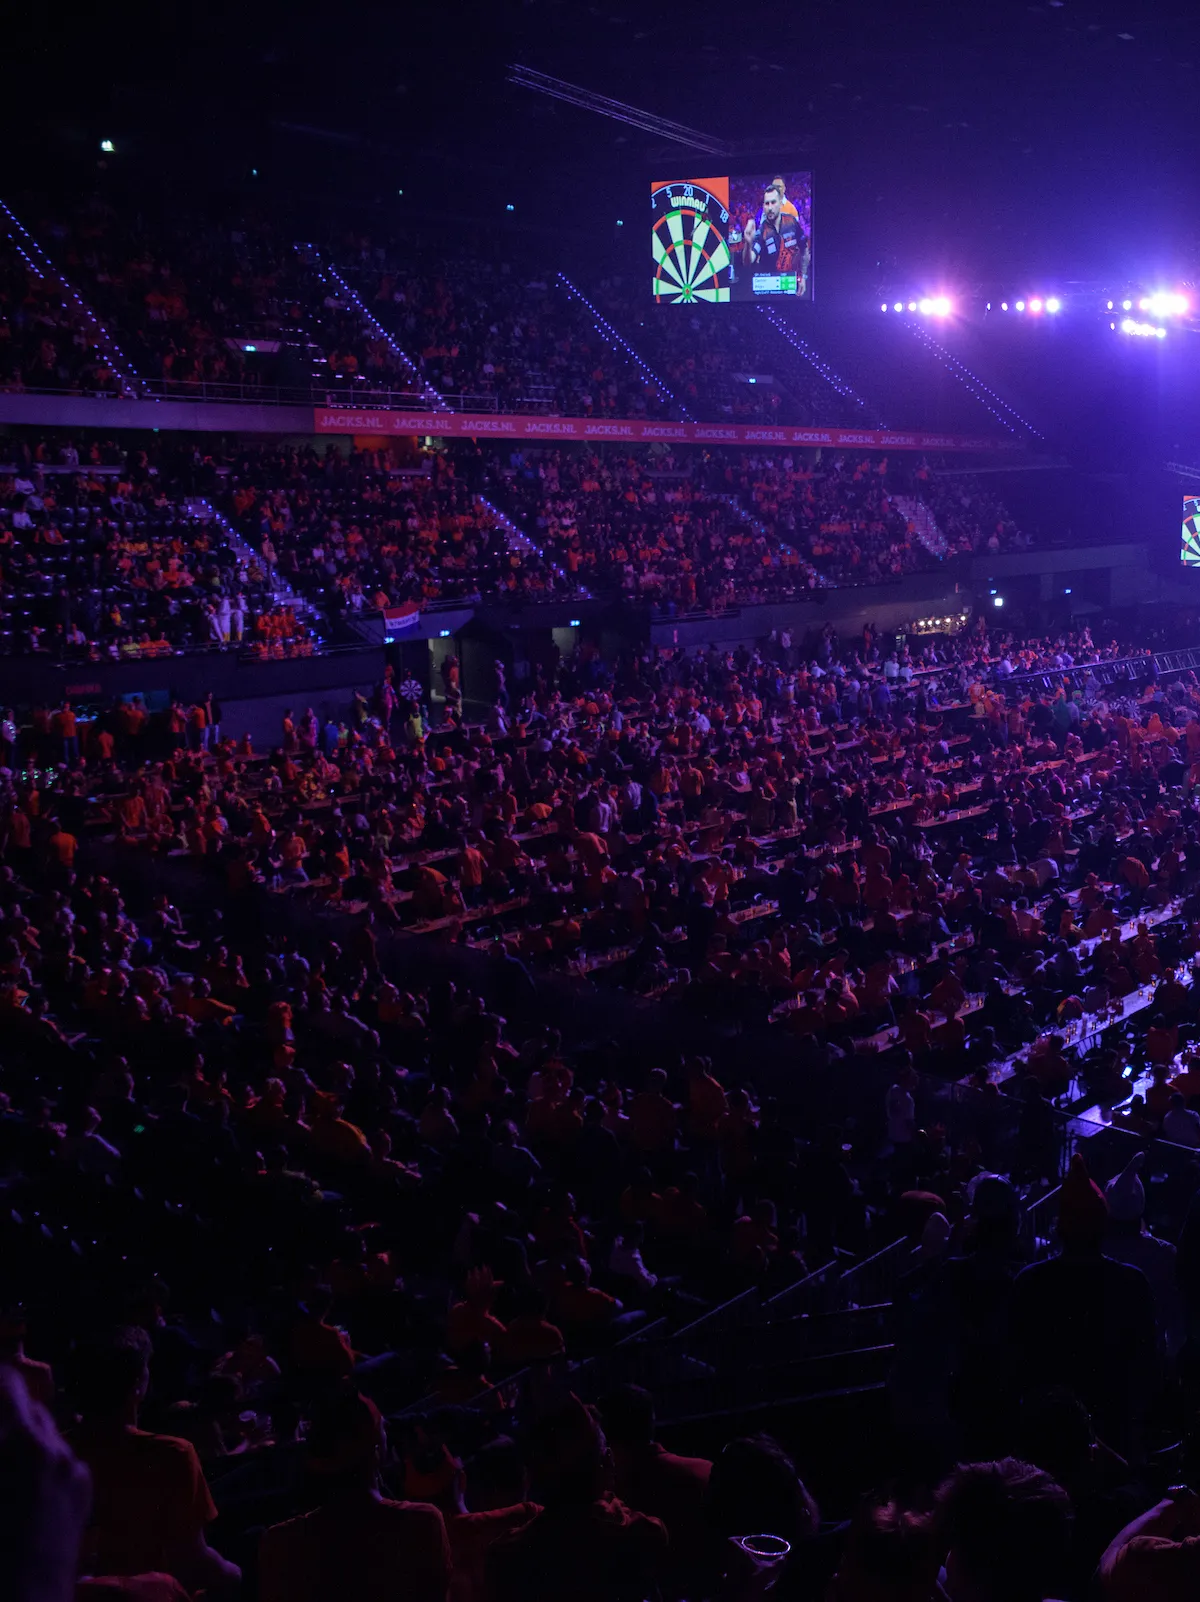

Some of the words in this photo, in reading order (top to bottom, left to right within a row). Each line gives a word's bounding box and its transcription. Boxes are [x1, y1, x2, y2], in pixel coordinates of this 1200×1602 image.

[683, 186, 693, 196] 20
[321, 416, 384, 428] JACKS.NL
[393, 418, 452, 430] JACKS.NL
[461, 420, 516, 432] JACKS.NL
[524, 423, 577, 434] JACKS.NL
[584, 425, 634, 436] JACKS.NL
[641, 427, 687, 438] JACKS.NL
[694, 428, 738, 439] JACKS.NL
[745, 431, 786, 441] JACKS.NL
